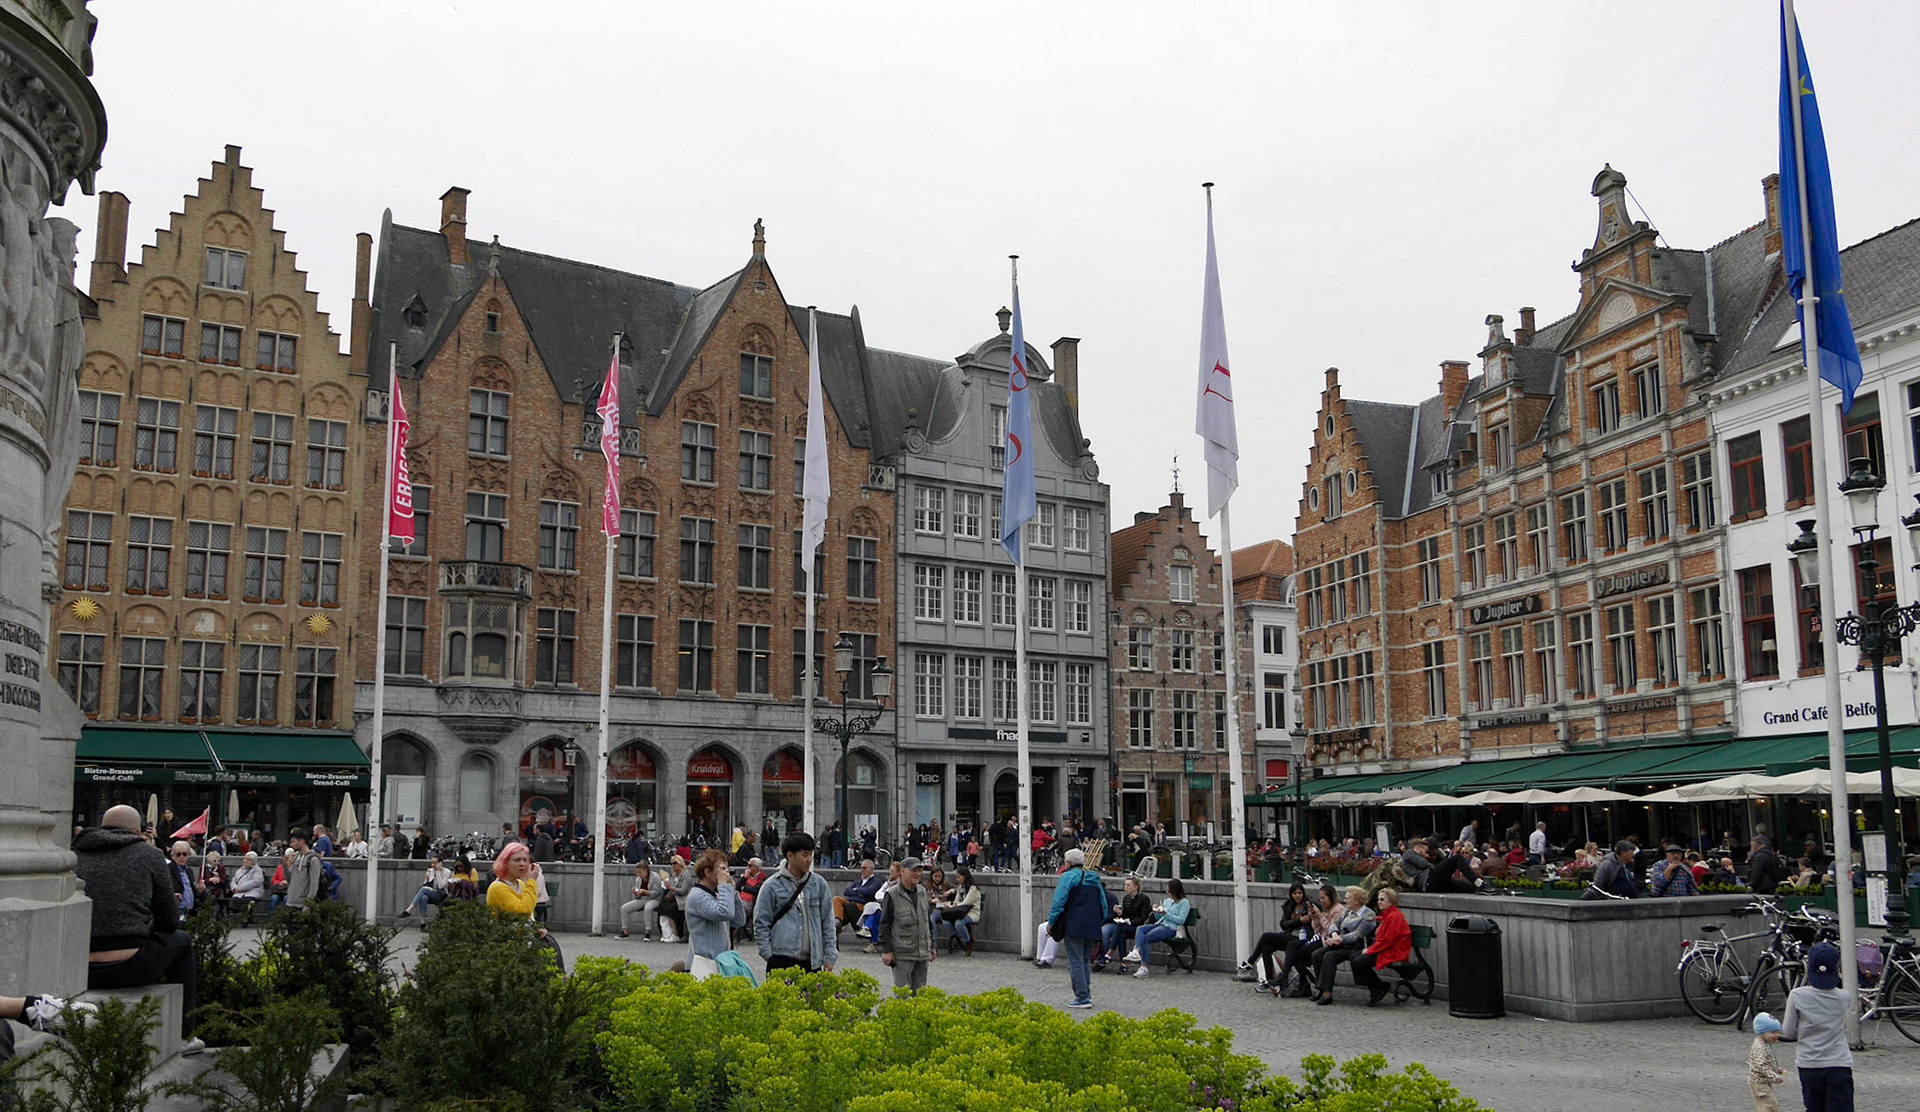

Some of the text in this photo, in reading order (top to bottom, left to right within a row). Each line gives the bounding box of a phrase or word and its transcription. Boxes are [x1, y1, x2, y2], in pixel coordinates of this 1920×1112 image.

[1608, 570, 1655, 592] Jupiler
[1486, 601, 1523, 619] Jupiler
[1502, 712, 1541, 725] SPORTMAN
[1764, 702, 1877, 725] Grand Café Belfo
[84, 767, 143, 776] Bistro-Brasserie
[691, 764, 724, 774] Kruidvat
[174, 771, 277, 783] Huyze Die Maene
[305, 772, 358, 780] Bistro-Brasserie
